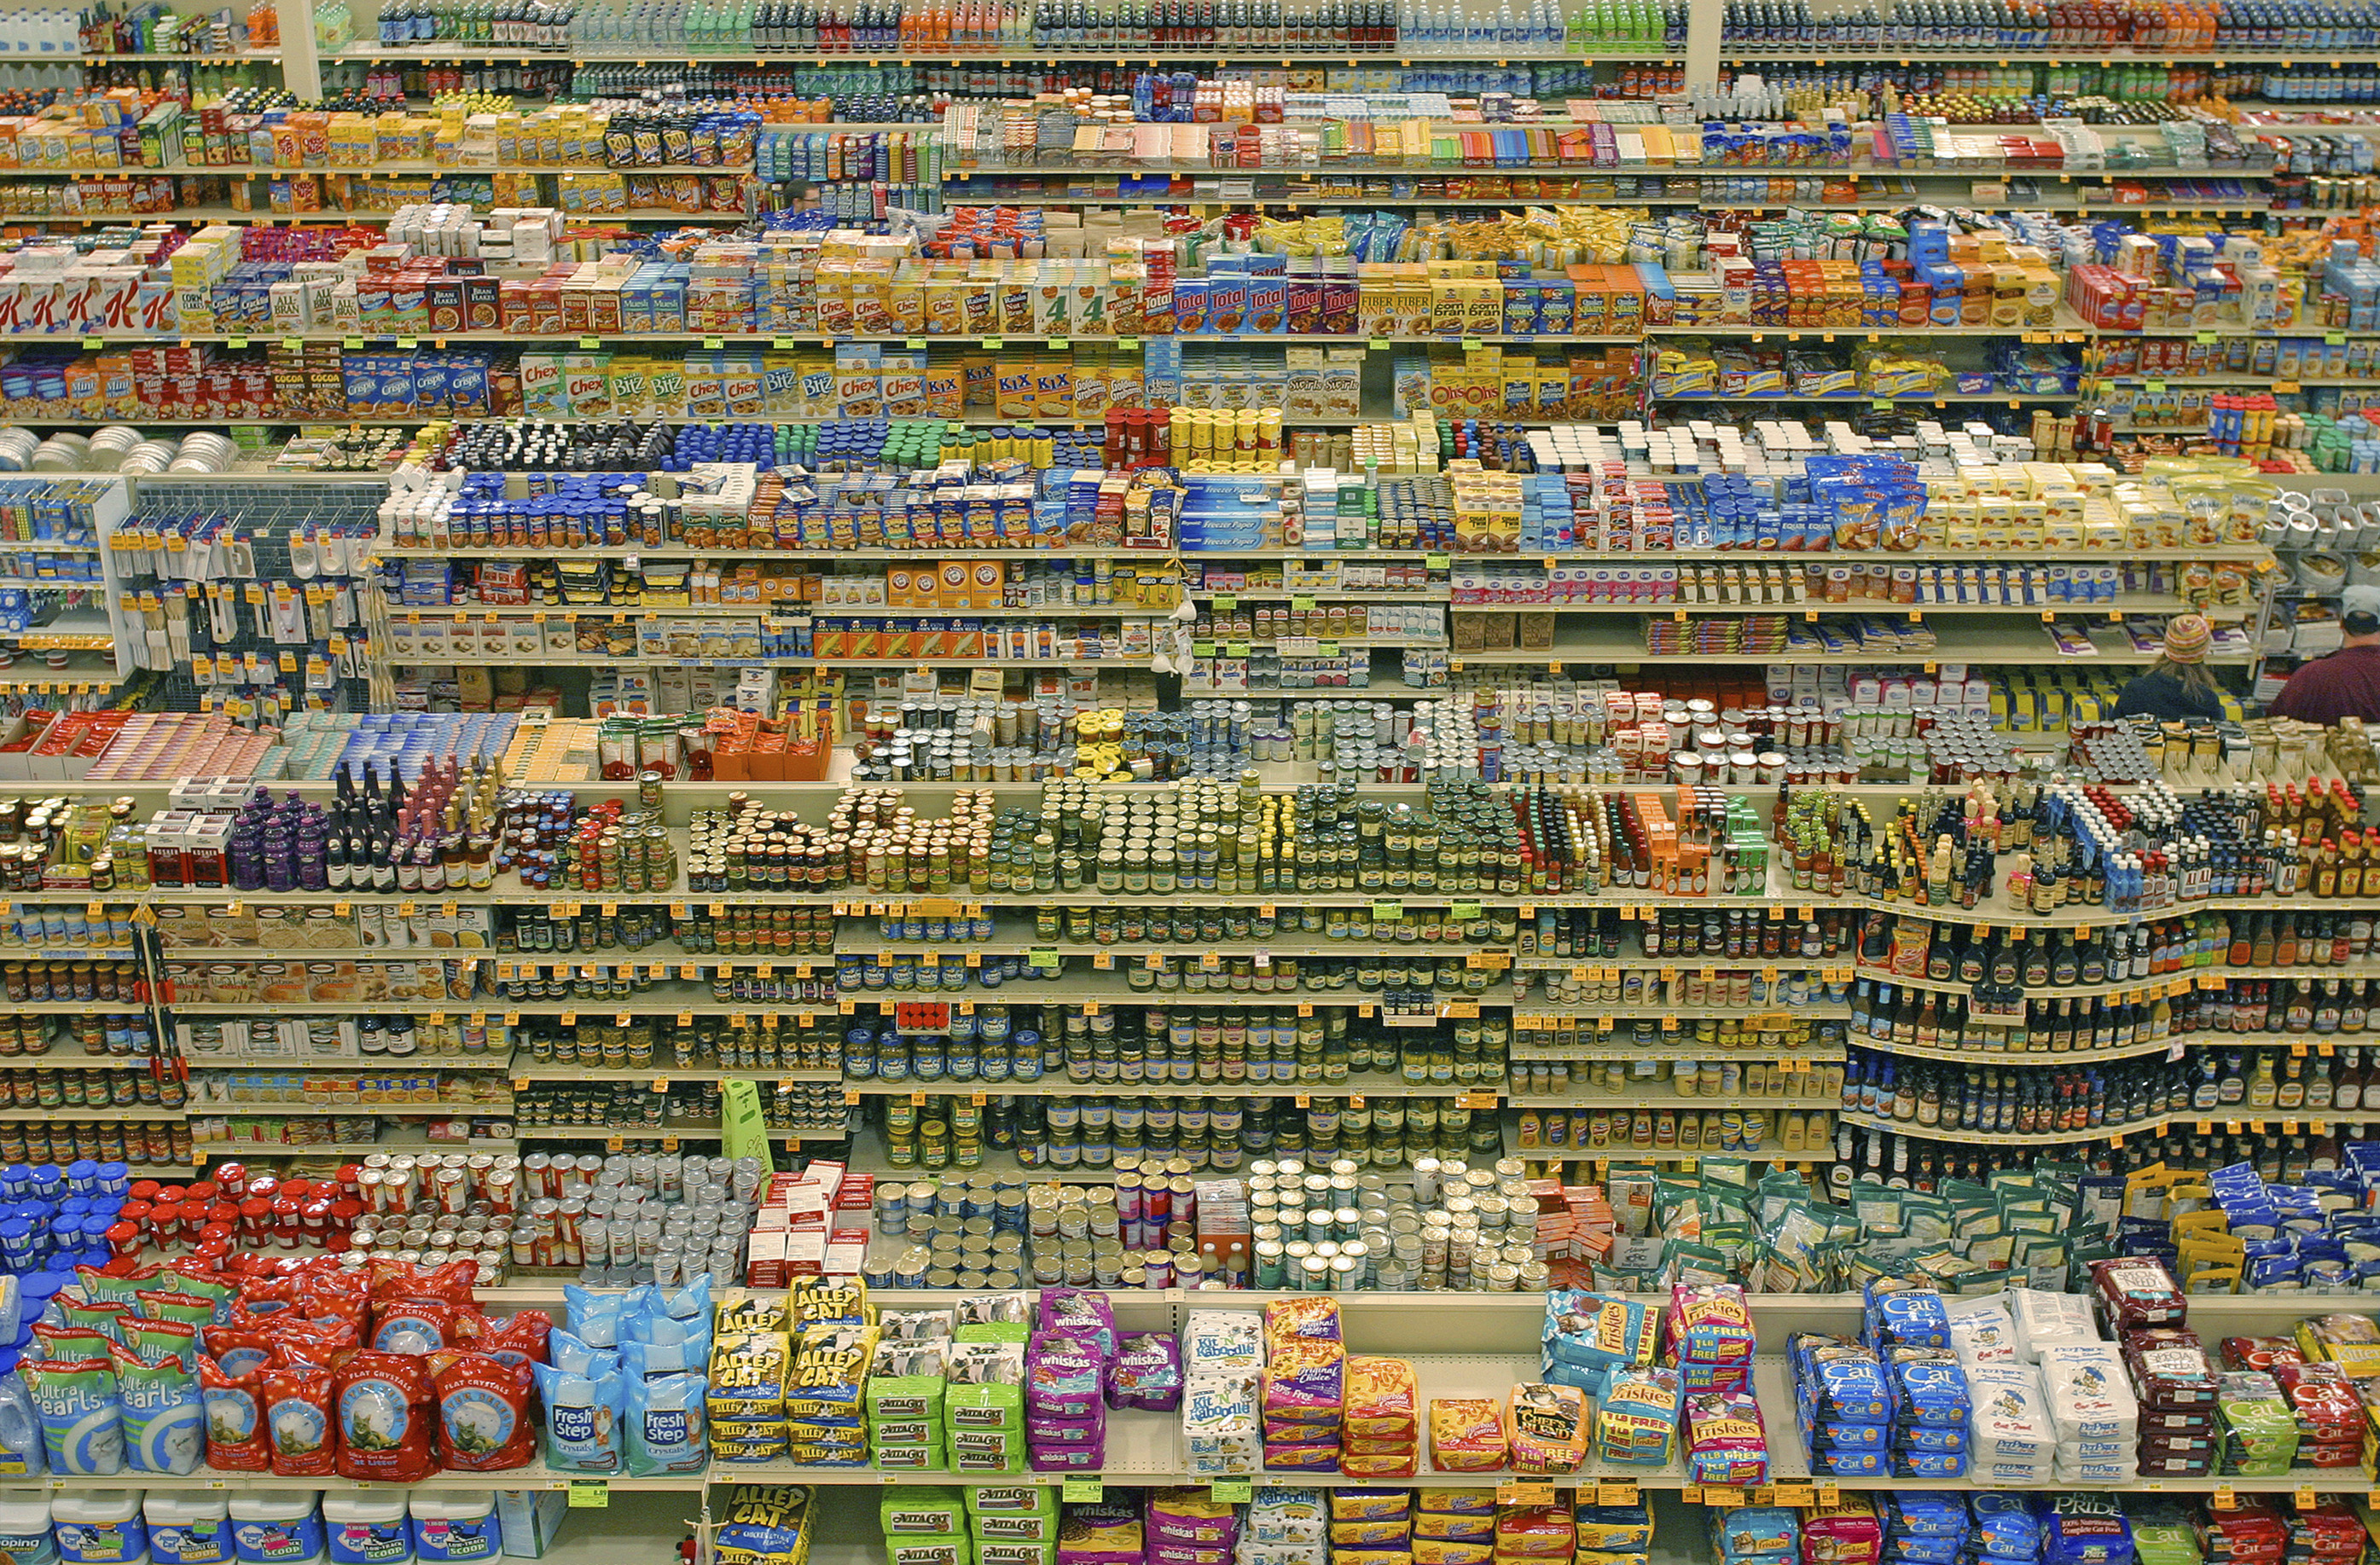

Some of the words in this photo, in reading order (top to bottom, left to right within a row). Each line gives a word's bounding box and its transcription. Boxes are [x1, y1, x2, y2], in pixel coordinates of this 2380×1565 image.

[1321, 188, 1362, 197] GIANT
[182, 293, 203, 302] CORN
[435, 290, 456, 299] BRAN
[471, 293, 495, 301] FLAKES
[472, 287, 492, 295] BRAN
[1211, 287, 1245, 308] Total
[1251, 287, 1285, 308] Total
[105, 280, 141, 328] K
[276, 297, 297, 305] ALL-
[433, 297, 458, 305] FLAKES
[624, 299, 649, 308] Muesli
[653, 299, 678, 308] Muesli
[1175, 291, 1207, 311] Total
[1289, 291, 1322, 310] Total
[1324, 290, 1358, 310] Total
[1361, 297, 1393, 307] FIBER
[1397, 297, 1428, 307] FIBER
[1647, 292, 1674, 310] Alpen
[142, 290, 174, 328] K
[274, 304, 299, 314] BRAN
[820, 300, 846, 315] Chex
[1046, 295, 1068, 321] 4
[1082, 295, 1104, 321] 4
[1360, 305, 1384, 315] ONE
[1396, 305, 1421, 315] ONE
[1434, 307, 1466, 316] bran
[1468, 307, 1501, 316] bran
[1505, 307, 1535, 316] Squares
[274, 374, 304, 383] COCOA
[525, 363, 559, 382] Chex
[416, 372, 446, 389] Crispix
[452, 372, 482, 389] Crispix
[612, 376, 646, 397] Bitz
[650, 376, 684, 396] Bitz
[802, 375, 835, 395] Bitz
[1075, 380, 1104, 391] Golden
[1288, 379, 1322, 391] Swirls
[1325, 379, 1360, 391] Swirls
[347, 380, 375, 395] Crispix
[690, 381, 721, 397] Chex
[841, 380, 878, 397] Chex
[885, 378, 921, 397] Chex
[1234, 486, 1256, 495] Paper
[1039, 519, 1058, 529] Meal
[2116, 1272, 2158, 1280] SPECIAL
[2124, 1278, 2162, 1288] NEEDS
[101, 1288, 136, 1302] Ultra
[797, 1288, 856, 1307] ALLEY
[804, 1301, 848, 1320] CAT
[1688, 1301, 1743, 1323] Friskies
[1884, 1297, 1936, 1314] Cat
[1054, 1317, 1103, 1328] whiskas
[1297, 1319, 1334, 1331] Original
[1605, 1304, 1620, 1355] Friskies
[798, 1349, 862, 1367] ALLEY
[1197, 1345, 1255, 1358] Kaboodle
[1692, 1349, 1717, 1359] FREE
[717, 1352, 781, 1370] ALLEY
[1041, 1357, 1090, 1368] whiskas
[2158, 1360, 2197, 1370] NEEDS
[721, 1366, 767, 1388] CAT
[801, 1366, 849, 1388] CAT
[1297, 1366, 1338, 1377] Original
[1824, 1365, 1875, 1382] Cat
[1905, 1366, 1953, 1384] Cat
[125, 1376, 159, 1390] Ultra
[349, 1370, 370, 1379] FLAT
[373, 1370, 413, 1392] CRYSTALS
[1298, 1374, 1331, 1383] Choice
[41, 1385, 77, 1400] Ultra
[444, 1382, 465, 1391] FLAT
[467, 1379, 509, 1394] CRYSTALS
[1272, 1383, 1291, 1396] 20%
[1376, 1393, 1408, 1403] Hairball
[2293, 1385, 2348, 1402] Cat
[715, 1404, 744, 1414] ALLEY
[753, 1402, 770, 1413] CAT
[1380, 1398, 1408, 1407] Control
[554, 1410, 593, 1425] Fresh
[1189, 1403, 1251, 1421] Kaboodle
[647, 1411, 684, 1429] Fresh
[1521, 1412, 1565, 1428] CHEF'S
[1994, 1422, 2013, 1431] Cat
[2014, 1422, 2033, 1431] Food
[556, 1423, 590, 1442] Step
[721, 1426, 747, 1436] ALLEY
[758, 1425, 775, 1436] CAT
[1464, 1423, 1496, 1434] Hairball
[1468, 1428, 1498, 1438] Control
[1522, 1423, 1570, 1438] BLEND
[1693, 1422, 1756, 1440] Friskies
[647, 1428, 684, 1445] Step
[1606, 1435, 1631, 1447] FREE
[558, 1443, 592, 1452] Crystals
[648, 1446, 684, 1455] Crystals
[716, 1446, 743, 1458] ALLEY
[755, 1445, 772, 1456] CAT
[1724, 1450, 1762, 1460] FREE
[1702, 1472, 1727, 1481] FREE
[733, 1486, 804, 1509] ALLEY
[2074, 1492, 2097, 1502] PET
[1072, 1506, 1135, 1517] whiskas
[2052, 1496, 2122, 1517] PRIDE
[734, 1504, 789, 1527] CAT
[1159, 1525, 1193, 1538] whiskas
[366, 1542, 403, 1551] LOW-TRACK
[449, 1539, 485, 1548] LOW-TRACK
[450, 1544, 485, 1556] SCOOP
[183, 1550, 217, 1560] SCOOP
[368, 1547, 403, 1558] SCOOP
